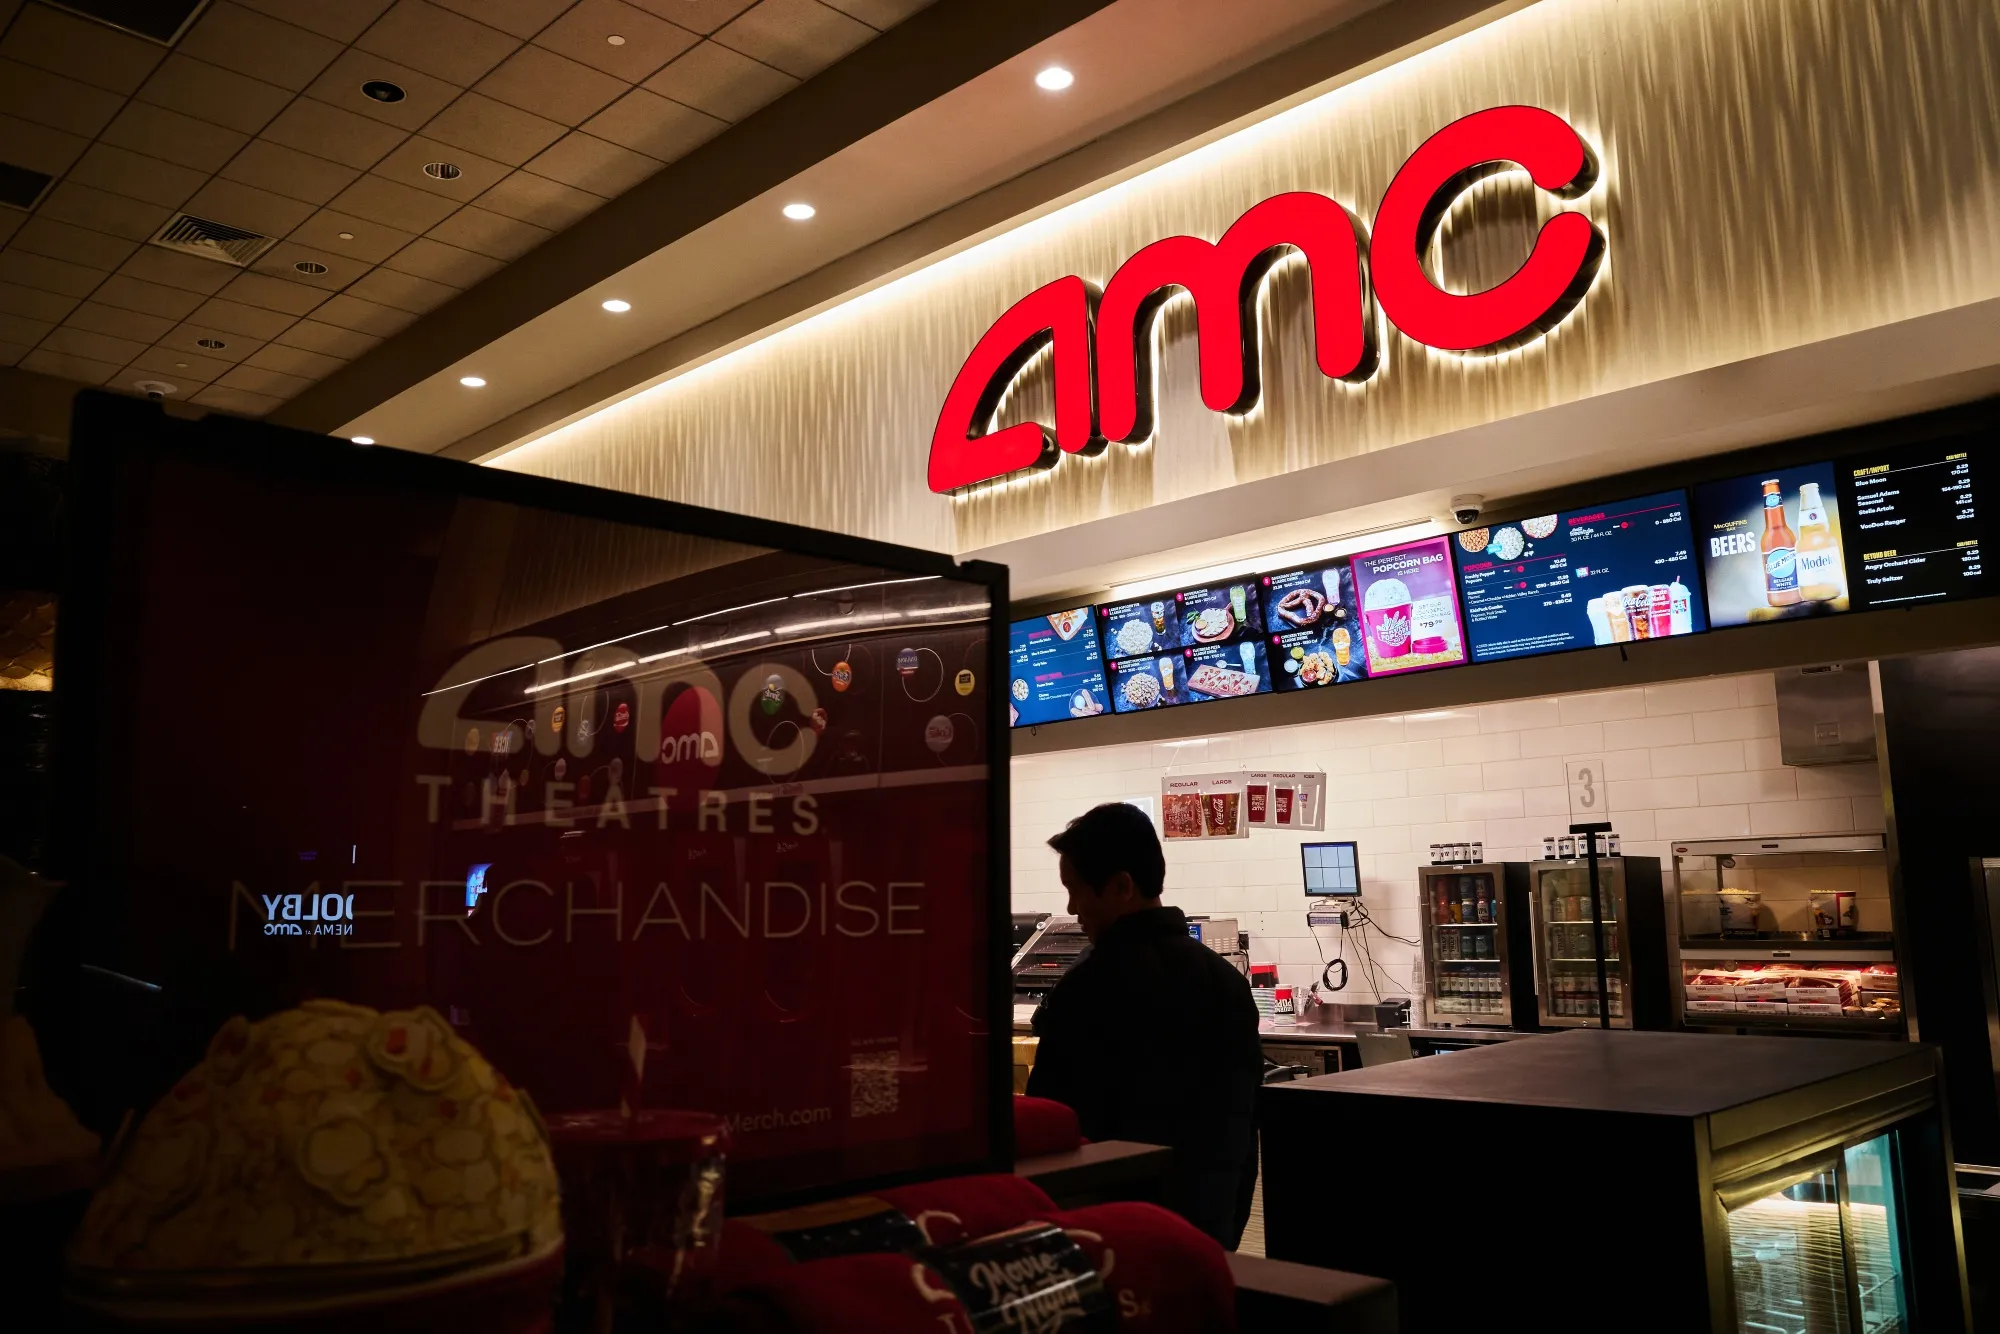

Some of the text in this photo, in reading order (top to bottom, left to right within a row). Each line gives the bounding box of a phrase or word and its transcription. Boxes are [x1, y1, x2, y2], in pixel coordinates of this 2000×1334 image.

[928, 105, 1598, 494] amc
[1858, 498, 1883, 506] Seasonal
[1876, 505, 1894, 513] Artois
[1568, 513, 1605, 525] BEVERAGES
[1885, 518, 1906, 527] Ranger
[1710, 532, 1756, 558] BEERS
[1373, 554, 1444, 574] POPCORN BAG
[1377, 554, 1407, 564] PERFECT
[1464, 562, 1492, 572] POPCORN
[1865, 563, 1883, 571] Angry
[1884, 559, 1908, 568] Orchard
[418, 636, 818, 775] amc
[1579, 768, 1595, 808] 3
[416, 775, 819, 835] THEATRES
[229, 879, 925, 950] MERCHANDISE
[970, 1253, 1058, 1304] Movie
